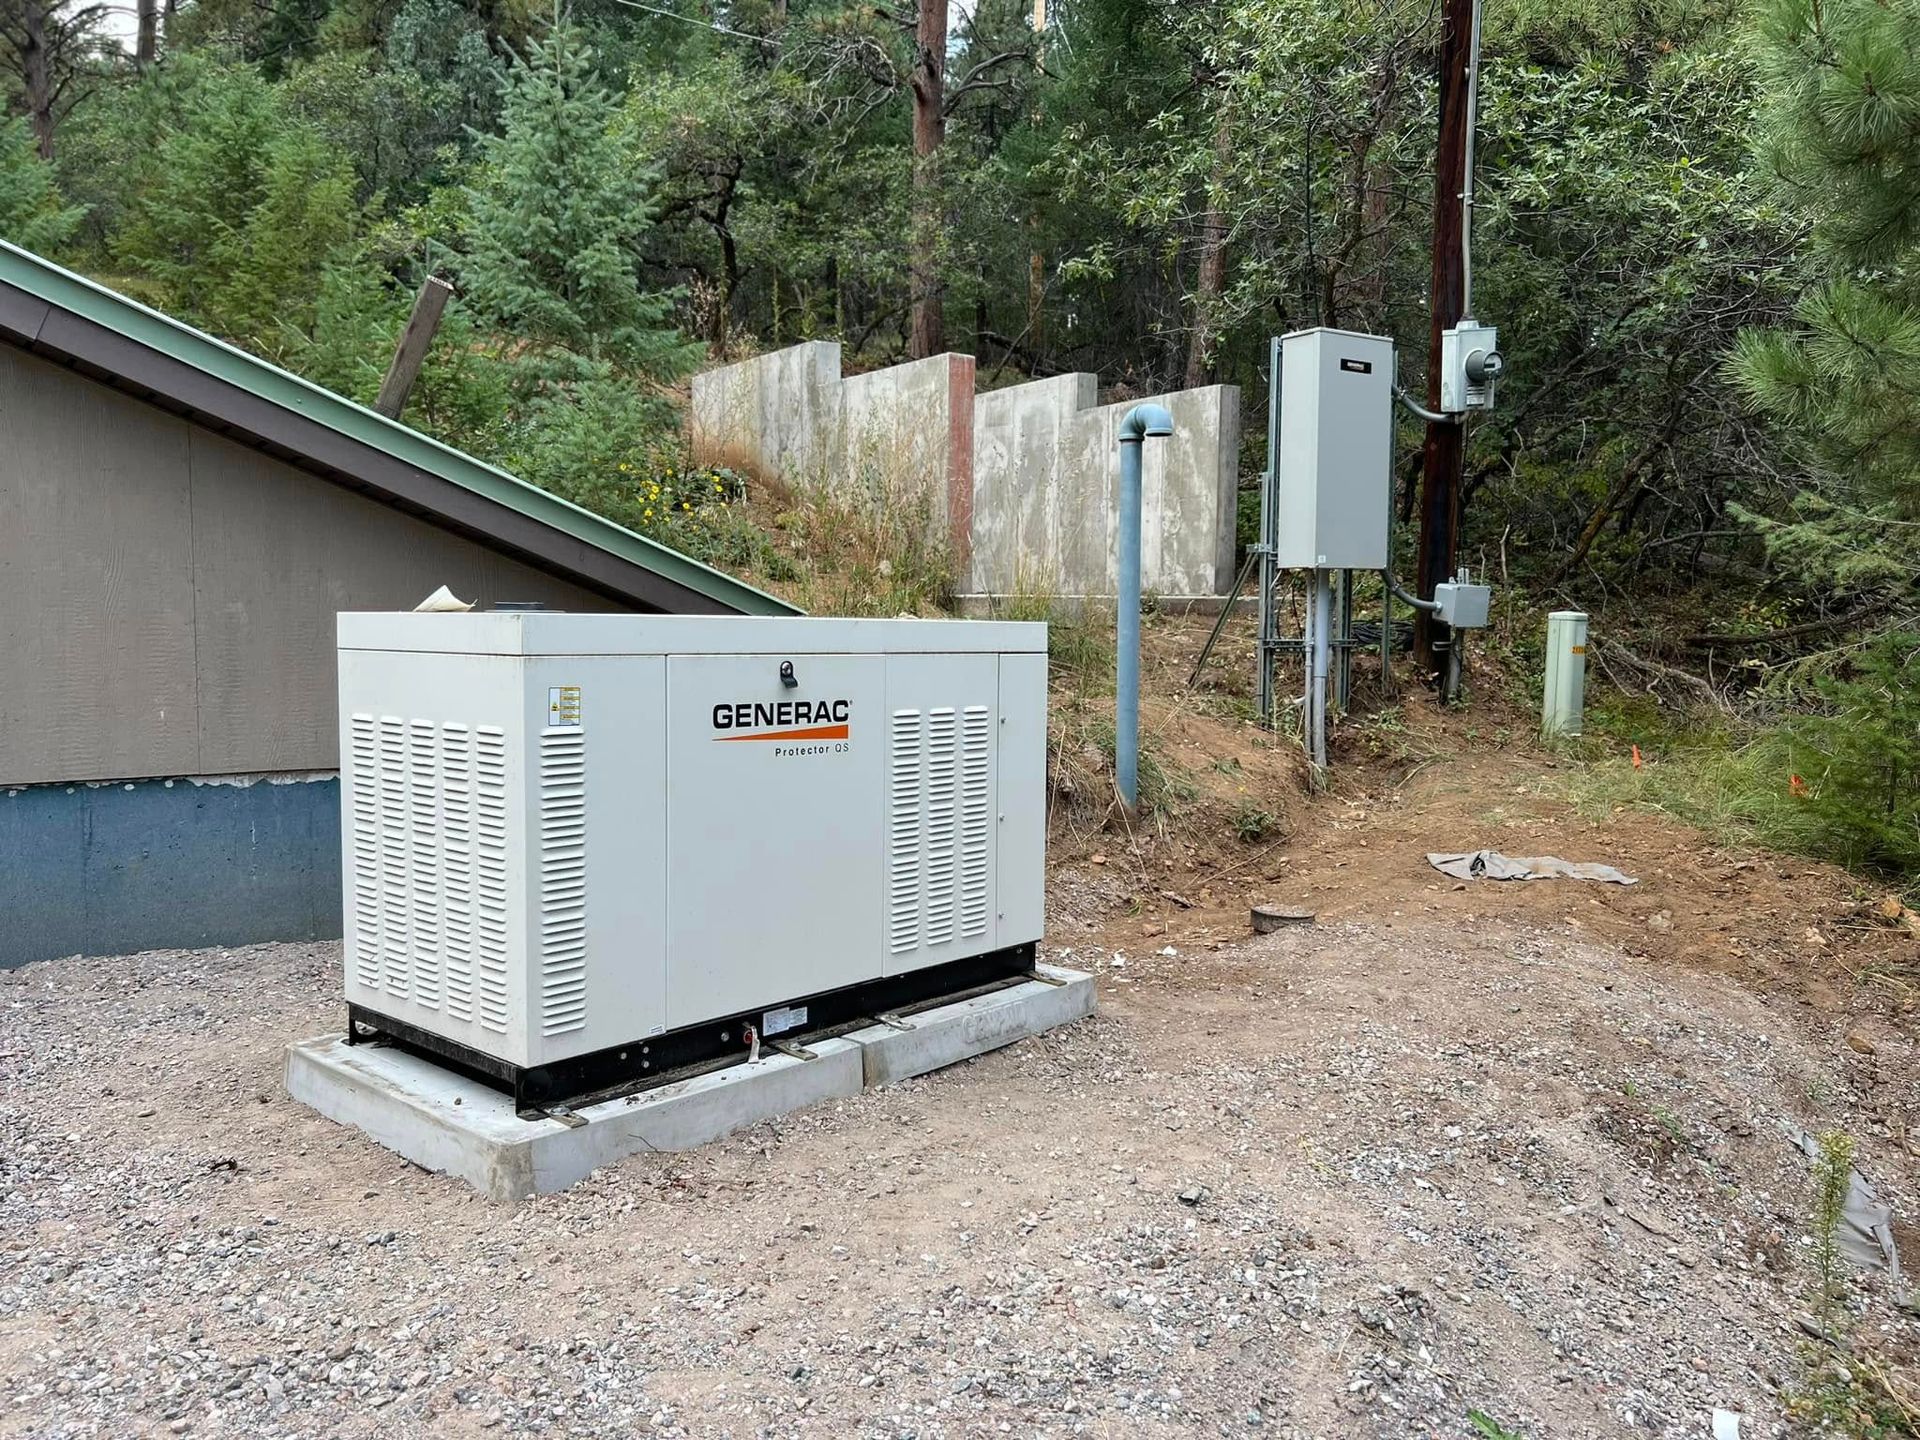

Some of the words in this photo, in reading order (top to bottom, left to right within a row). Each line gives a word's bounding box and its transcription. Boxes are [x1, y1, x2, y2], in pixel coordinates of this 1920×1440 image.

[713, 700, 849, 729] GENERAC
[775, 745, 830, 757] Protector
[835, 742, 849, 753] QS
